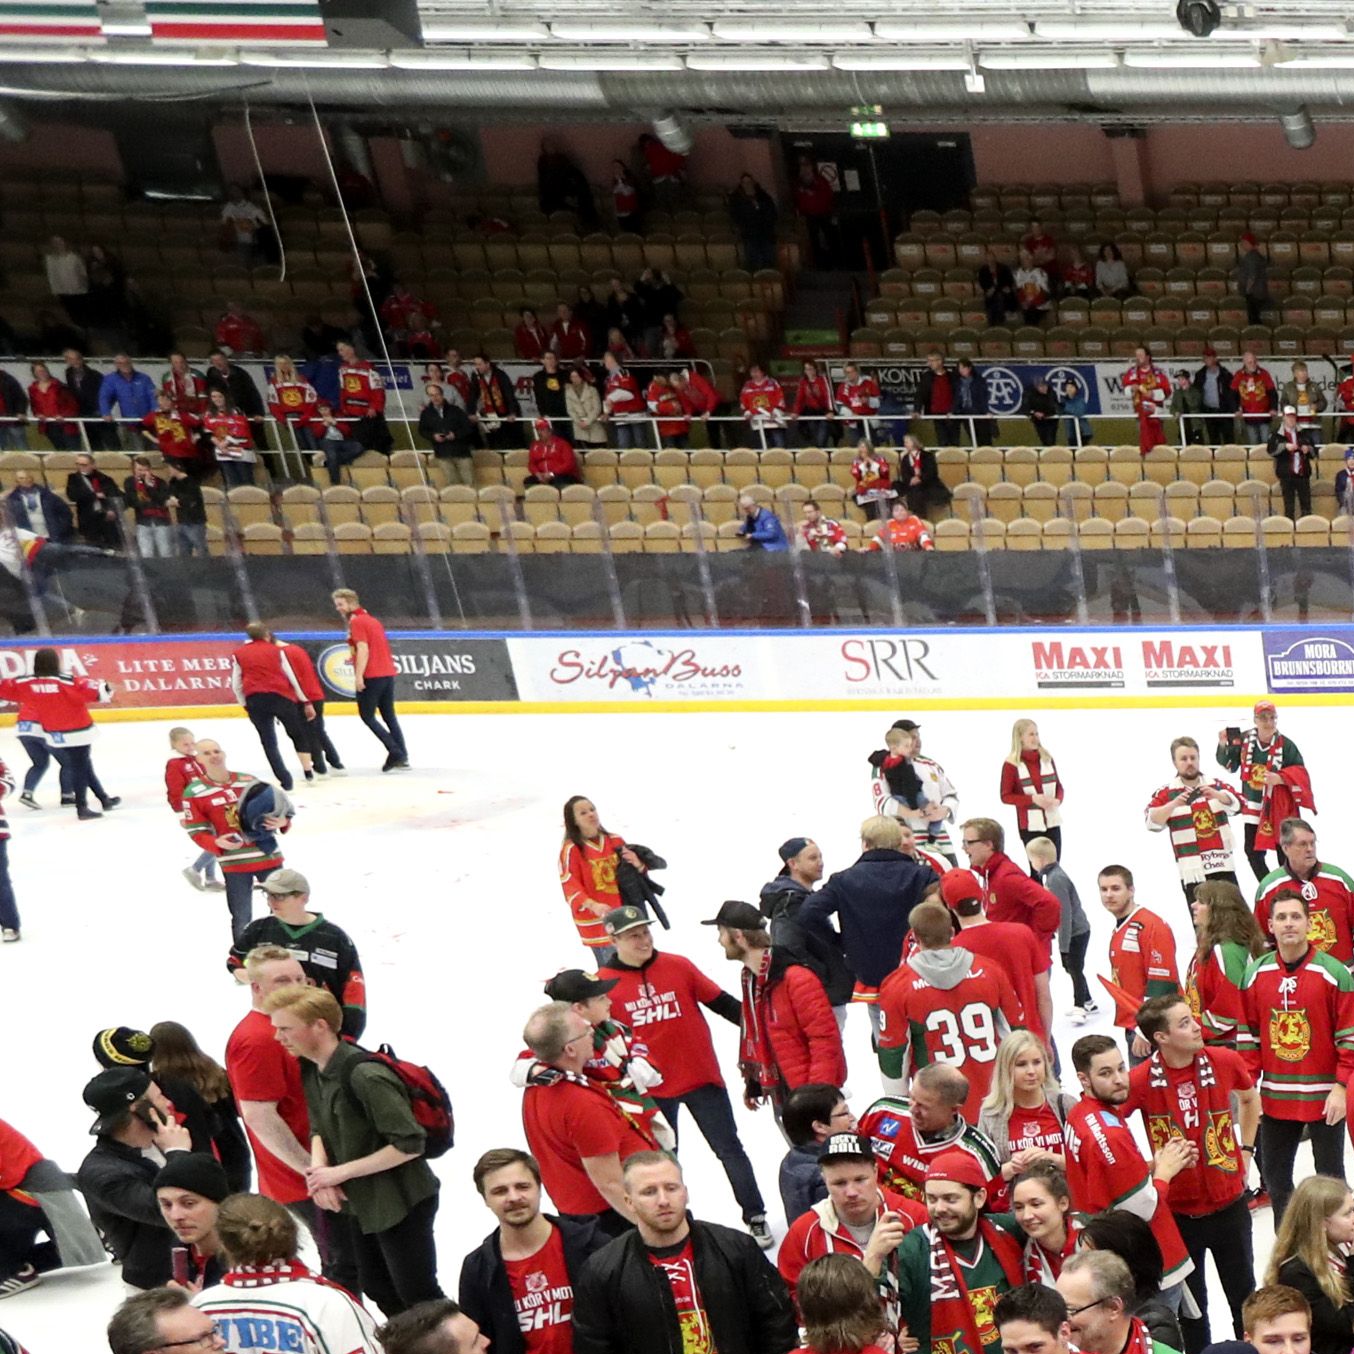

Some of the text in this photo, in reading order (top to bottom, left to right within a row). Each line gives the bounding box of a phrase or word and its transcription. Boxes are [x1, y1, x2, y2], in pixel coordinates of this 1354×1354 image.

[841, 640, 939, 681] SRR
[1031, 641, 1124, 670] MAXI
[1141, 640, 1233, 668] MAXI
[1304, 644, 1337, 659] MORA
[118, 658, 175, 673] LITE
[391, 654, 476, 676] SILJANS
[1052, 670, 1125, 679] STORMARKNAD
[1161, 669, 1234, 678] STORMARKNAD
[414, 680, 461, 690] CHARK
[631, 1000, 682, 1028] SHL!
[925, 1002, 996, 1069] 39
[1045, 1132, 1062, 1146] MOT
[520, 1303, 573, 1333] SHL
